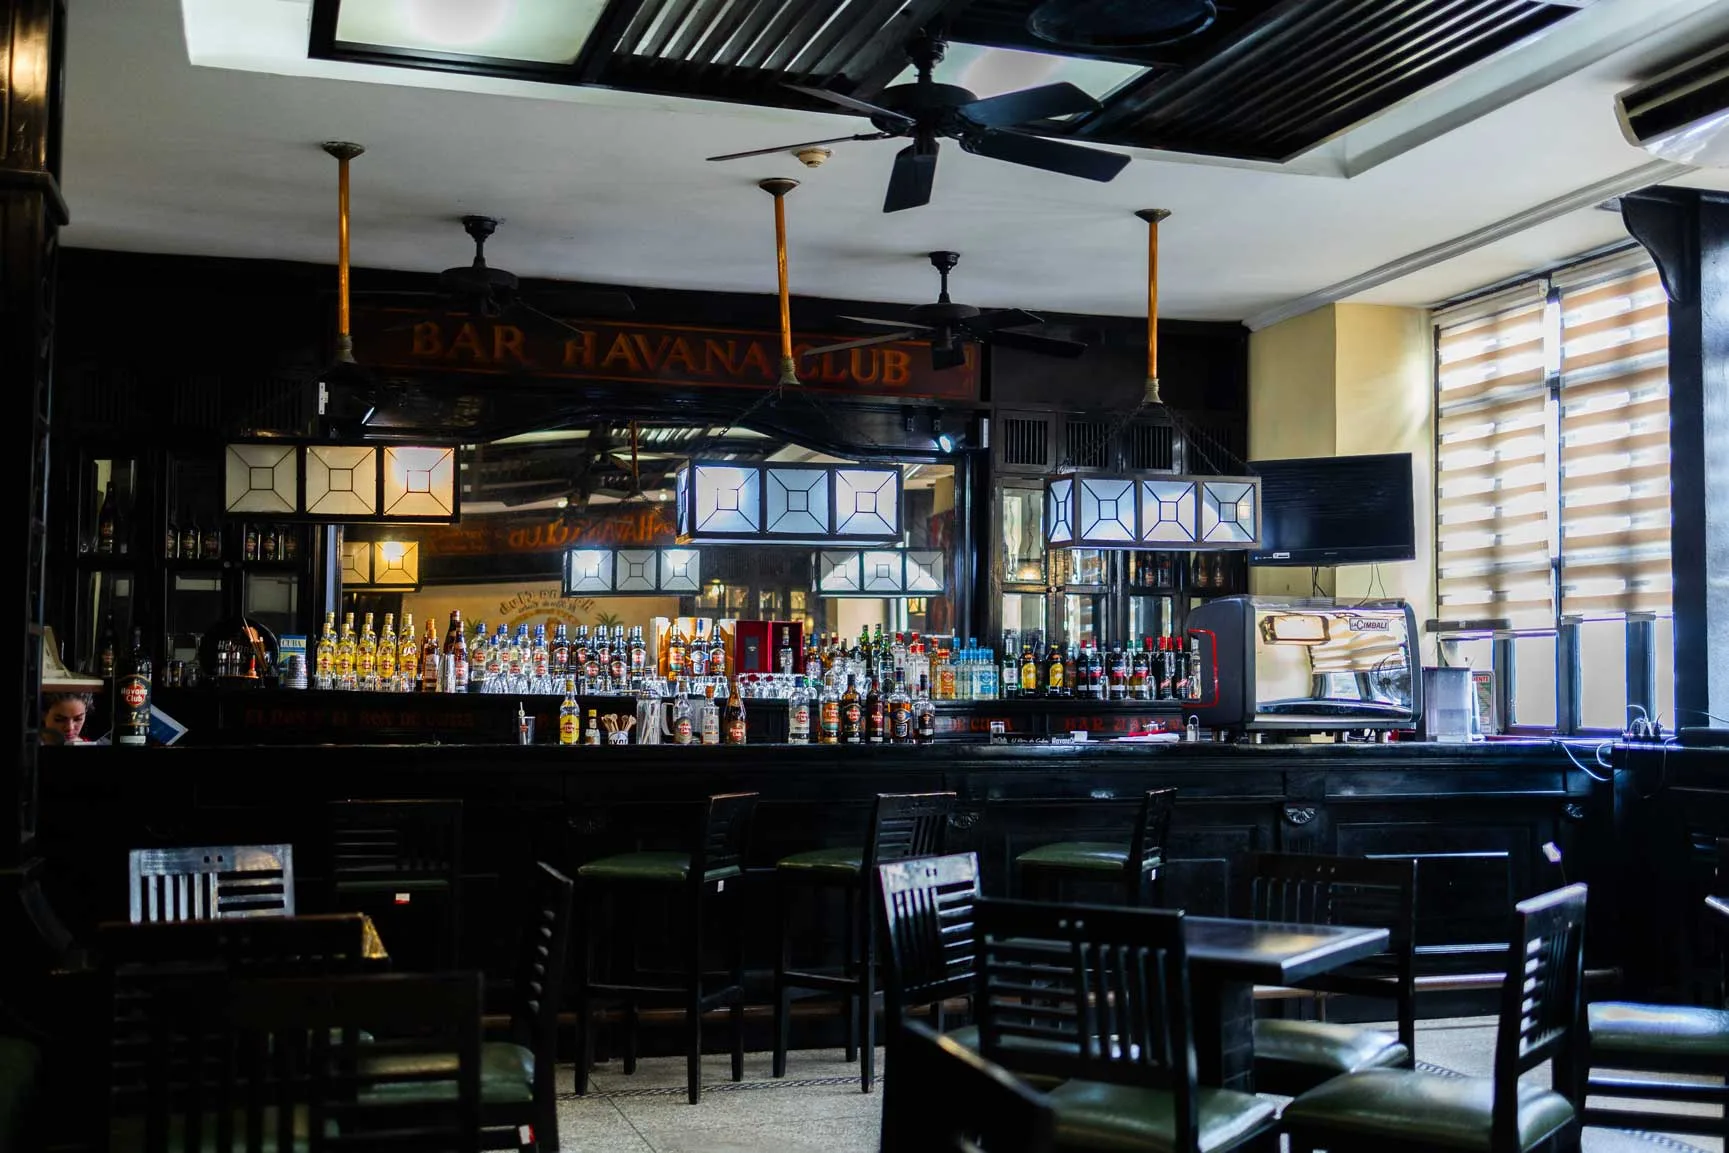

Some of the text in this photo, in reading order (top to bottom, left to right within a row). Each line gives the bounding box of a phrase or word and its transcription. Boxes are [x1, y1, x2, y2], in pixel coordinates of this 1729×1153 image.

[412, 320, 912, 386] BAR HAVANA CLUB
[1357, 620, 1387, 630] CIMBALI
[121, 687, 148, 696] Havana
